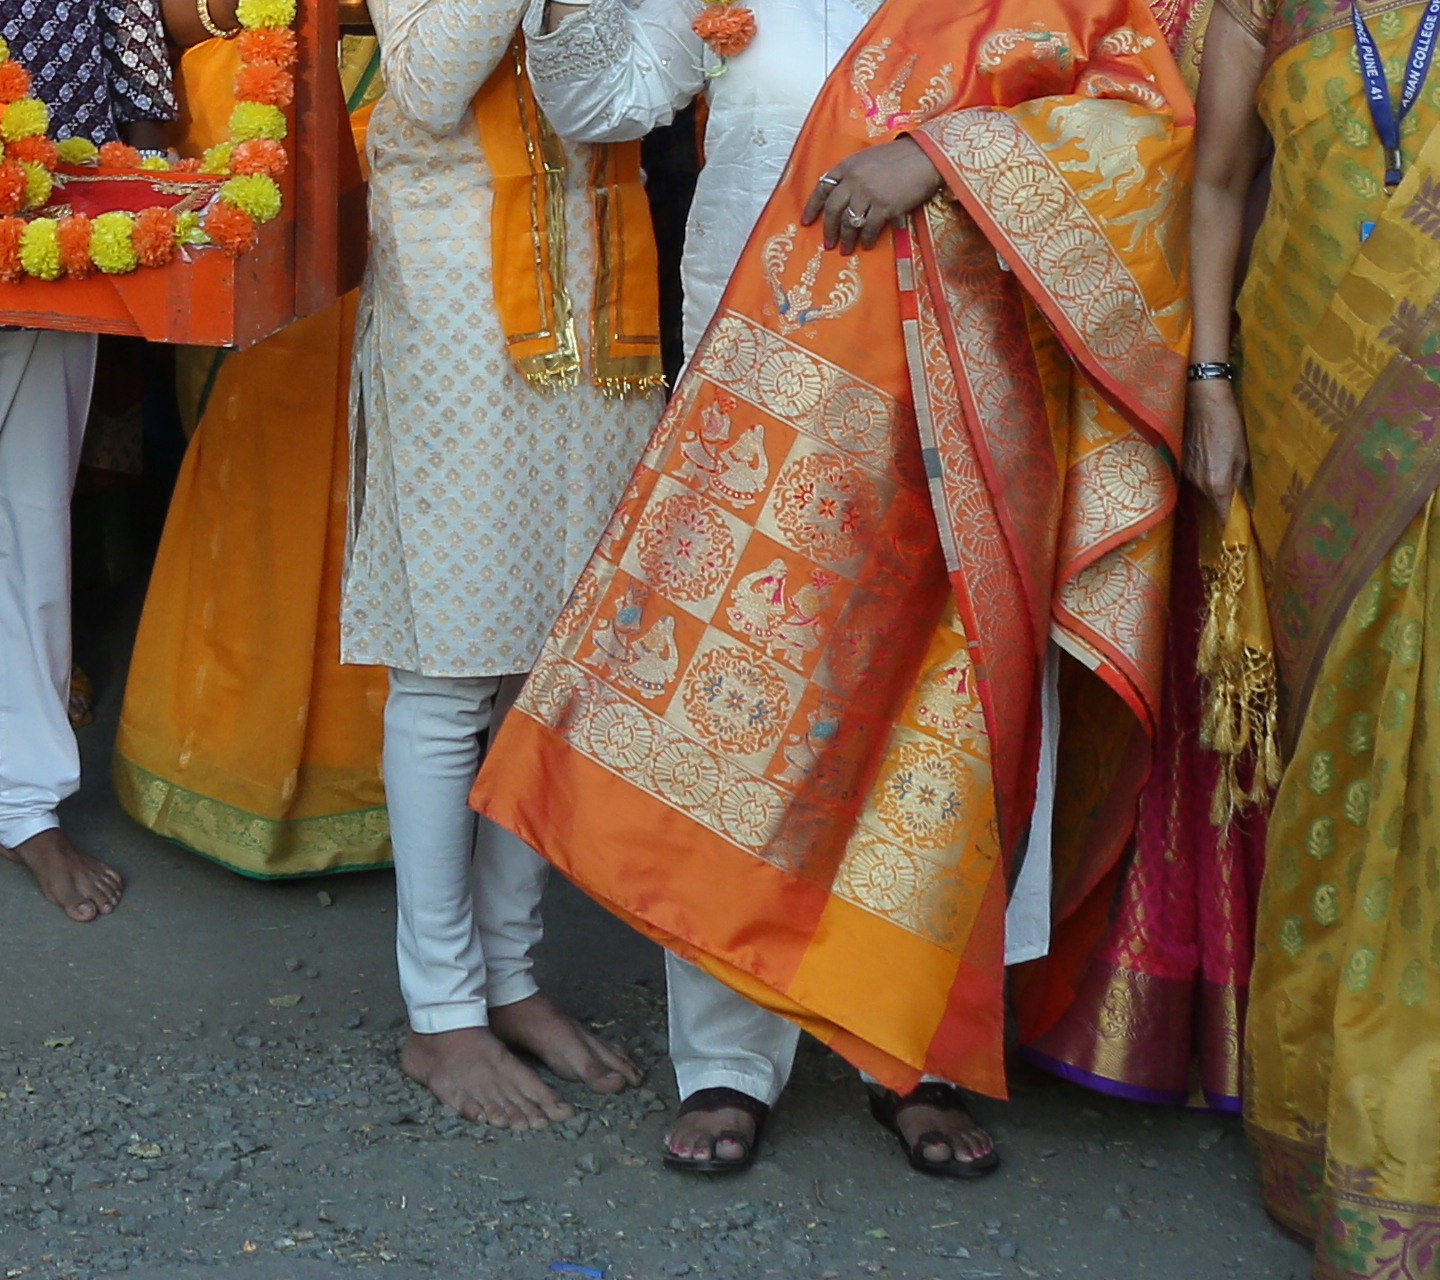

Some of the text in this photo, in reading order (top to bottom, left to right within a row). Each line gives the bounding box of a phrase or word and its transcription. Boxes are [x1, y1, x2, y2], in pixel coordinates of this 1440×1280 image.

[1361, 44, 1379, 77] PUNE
[1401, 70, 1421, 108] ASIAN
[1412, 20, 1435, 71] COLLEGE
